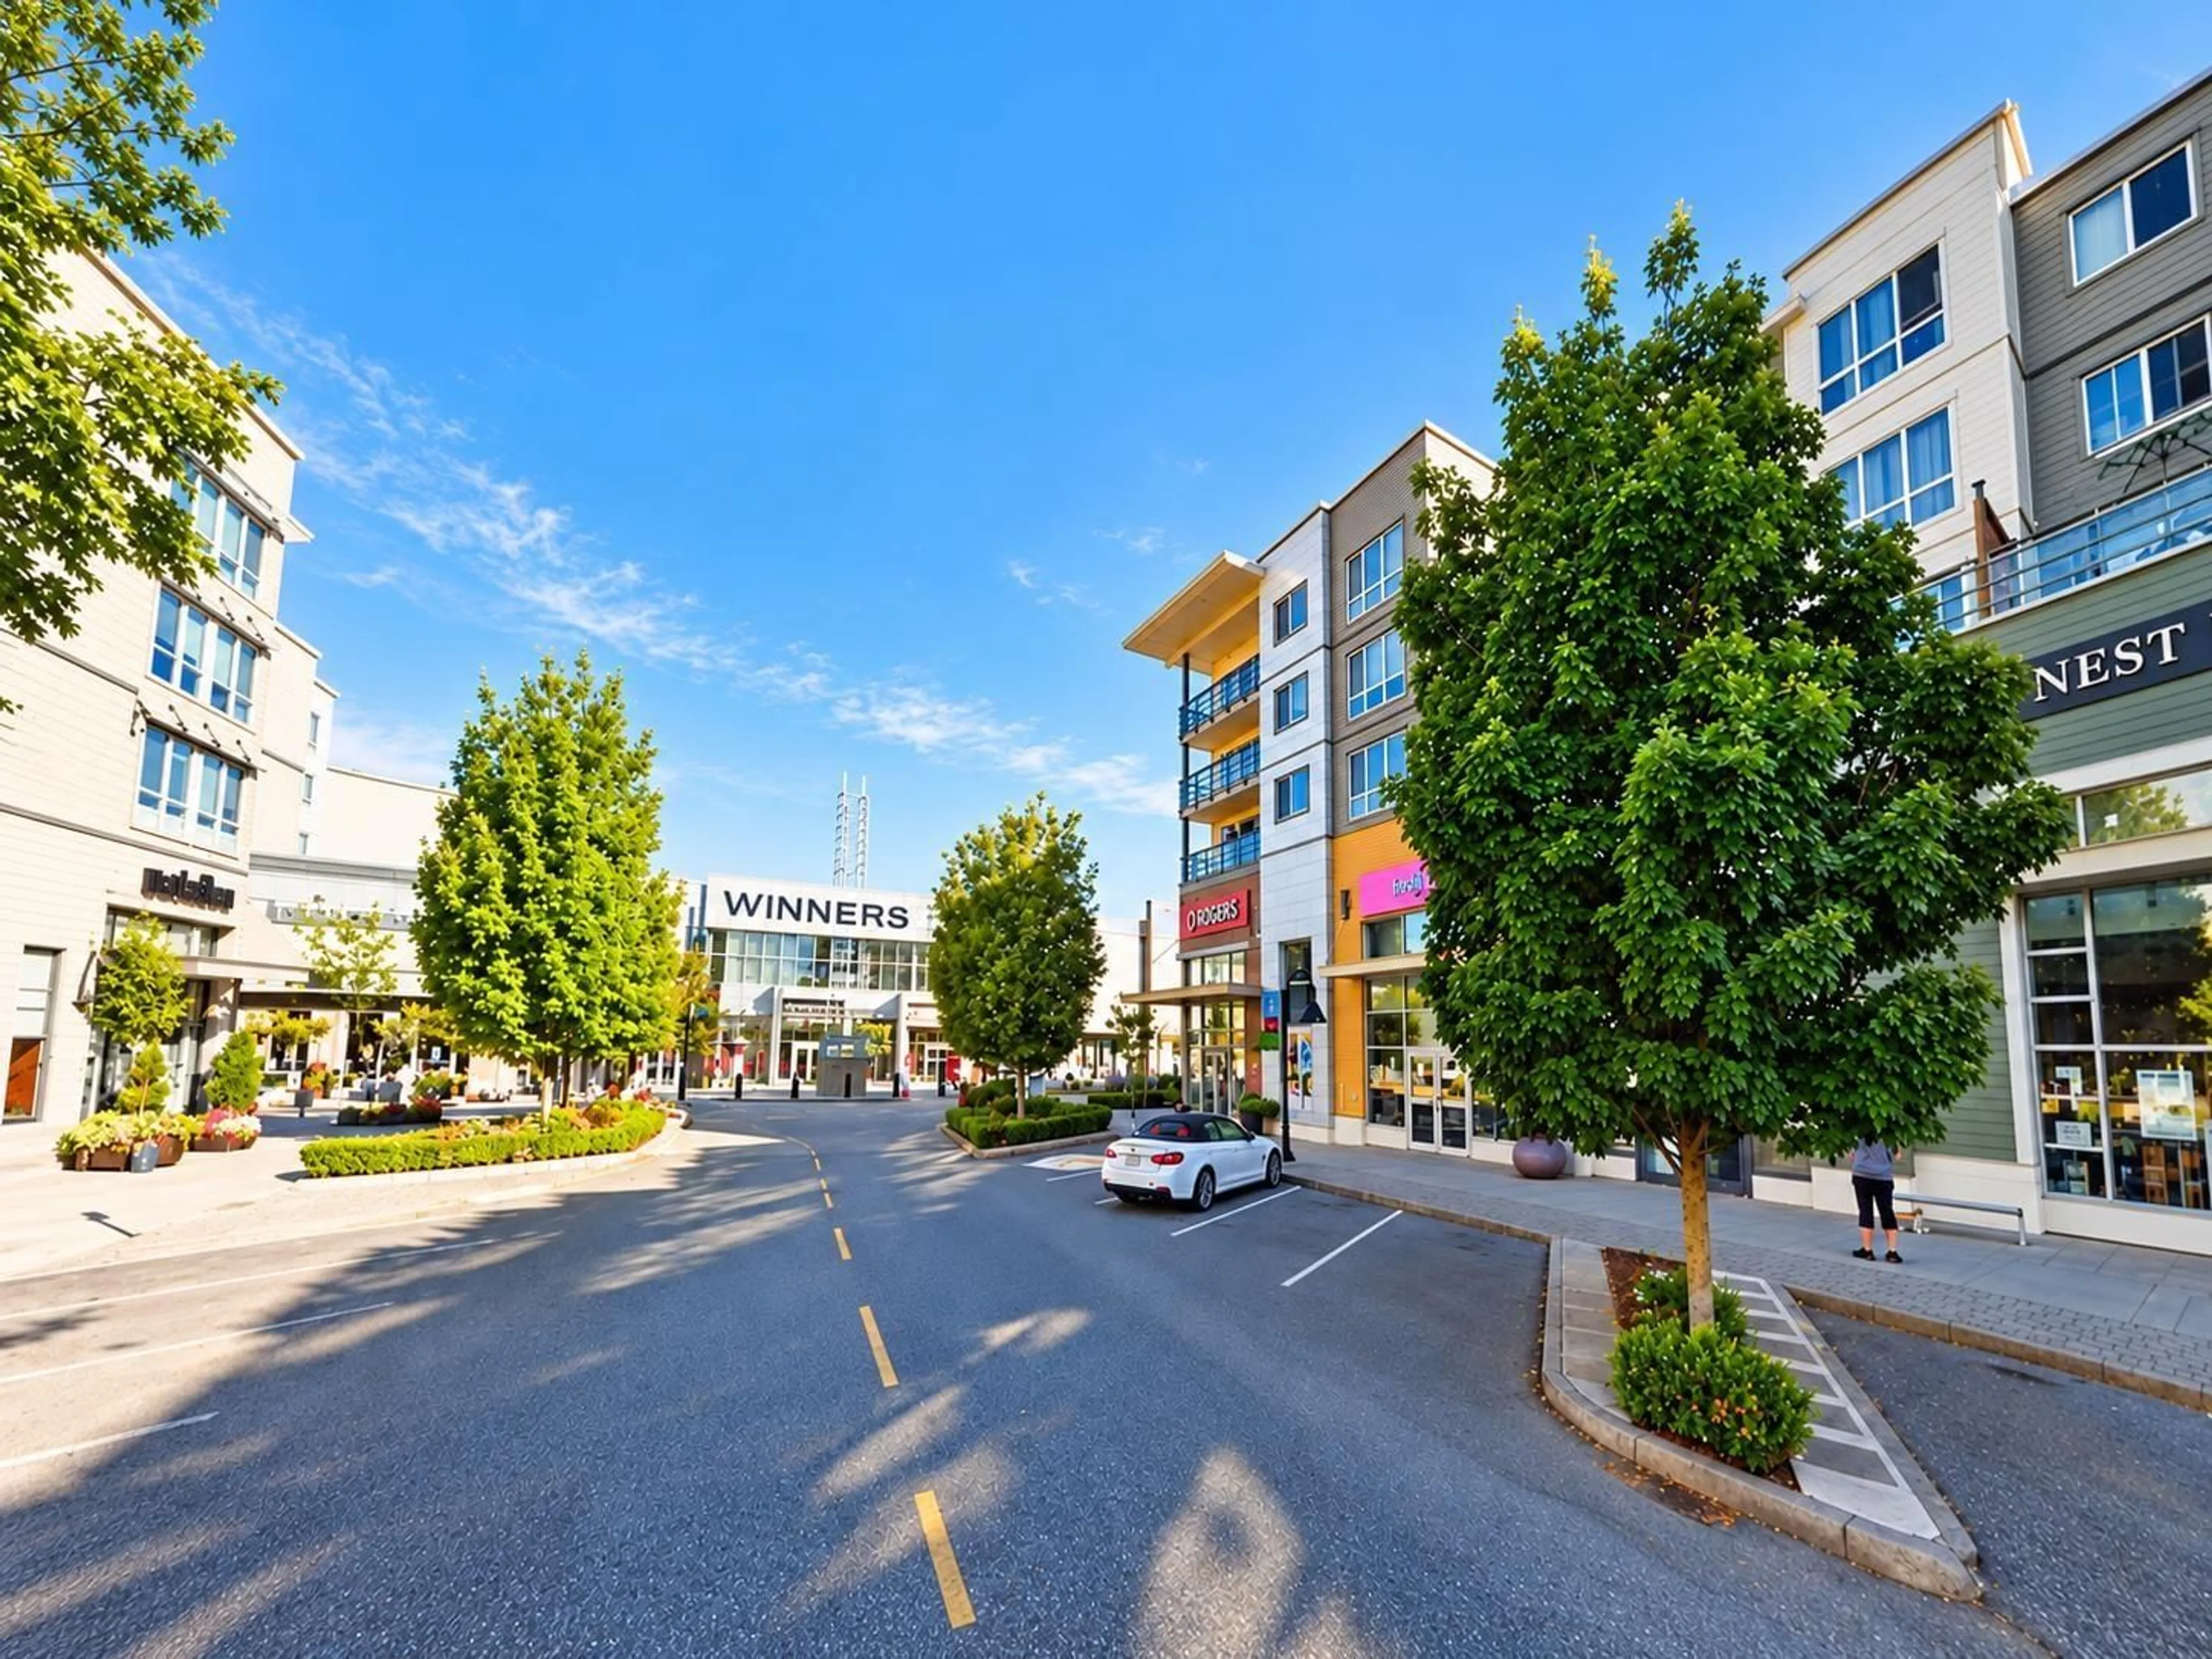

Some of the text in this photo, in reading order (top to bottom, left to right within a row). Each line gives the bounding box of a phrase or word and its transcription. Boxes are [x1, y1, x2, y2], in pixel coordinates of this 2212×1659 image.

[2031, 622, 2186, 702] NEST
[724, 890, 909, 929] WINNERS
[1197, 898, 1238, 926] ROGERS
